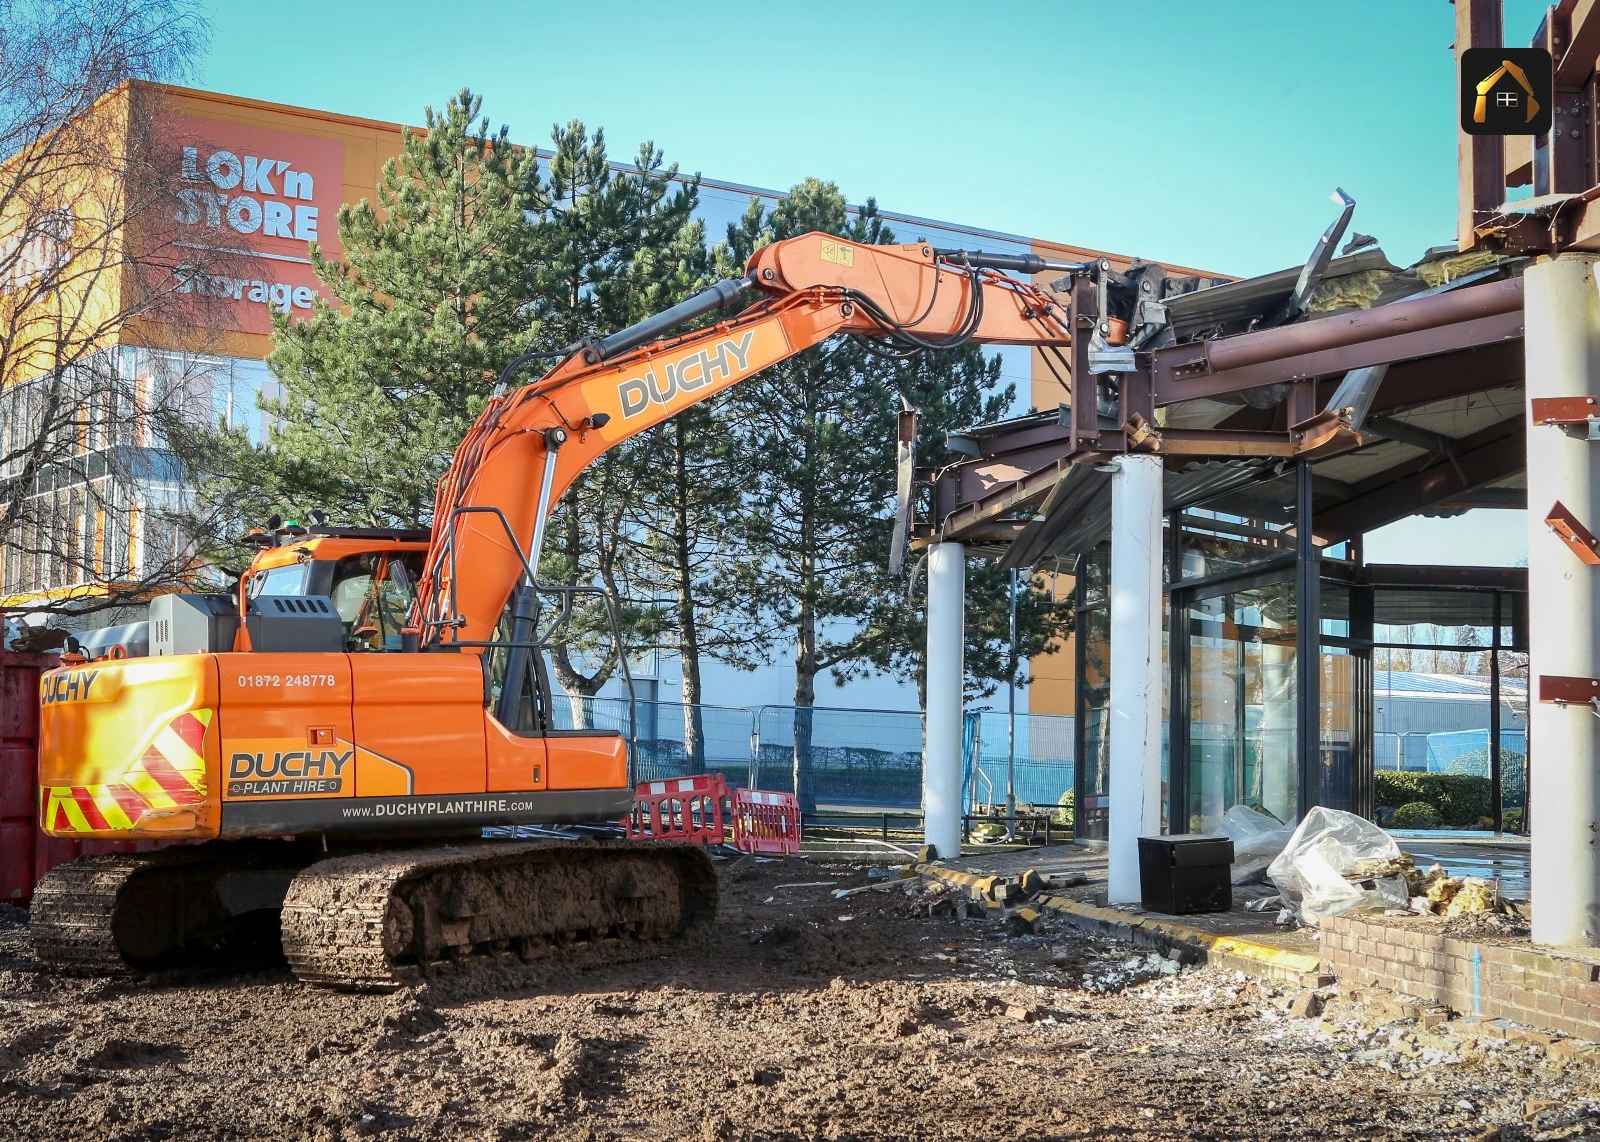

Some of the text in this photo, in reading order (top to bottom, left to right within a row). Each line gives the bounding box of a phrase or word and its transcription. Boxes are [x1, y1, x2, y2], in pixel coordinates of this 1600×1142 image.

[181, 146, 314, 200] LOK'n
[174, 188, 319, 242] STORE
[172, 263, 313, 313] Storage
[618, 329, 755, 420] DUCHY
[41, 670, 100, 706] DUCHY
[238, 674, 336, 688] 01872 248778
[229, 750, 354, 779] DUCHY
[243, 780, 326, 794] PLANT HIRE
